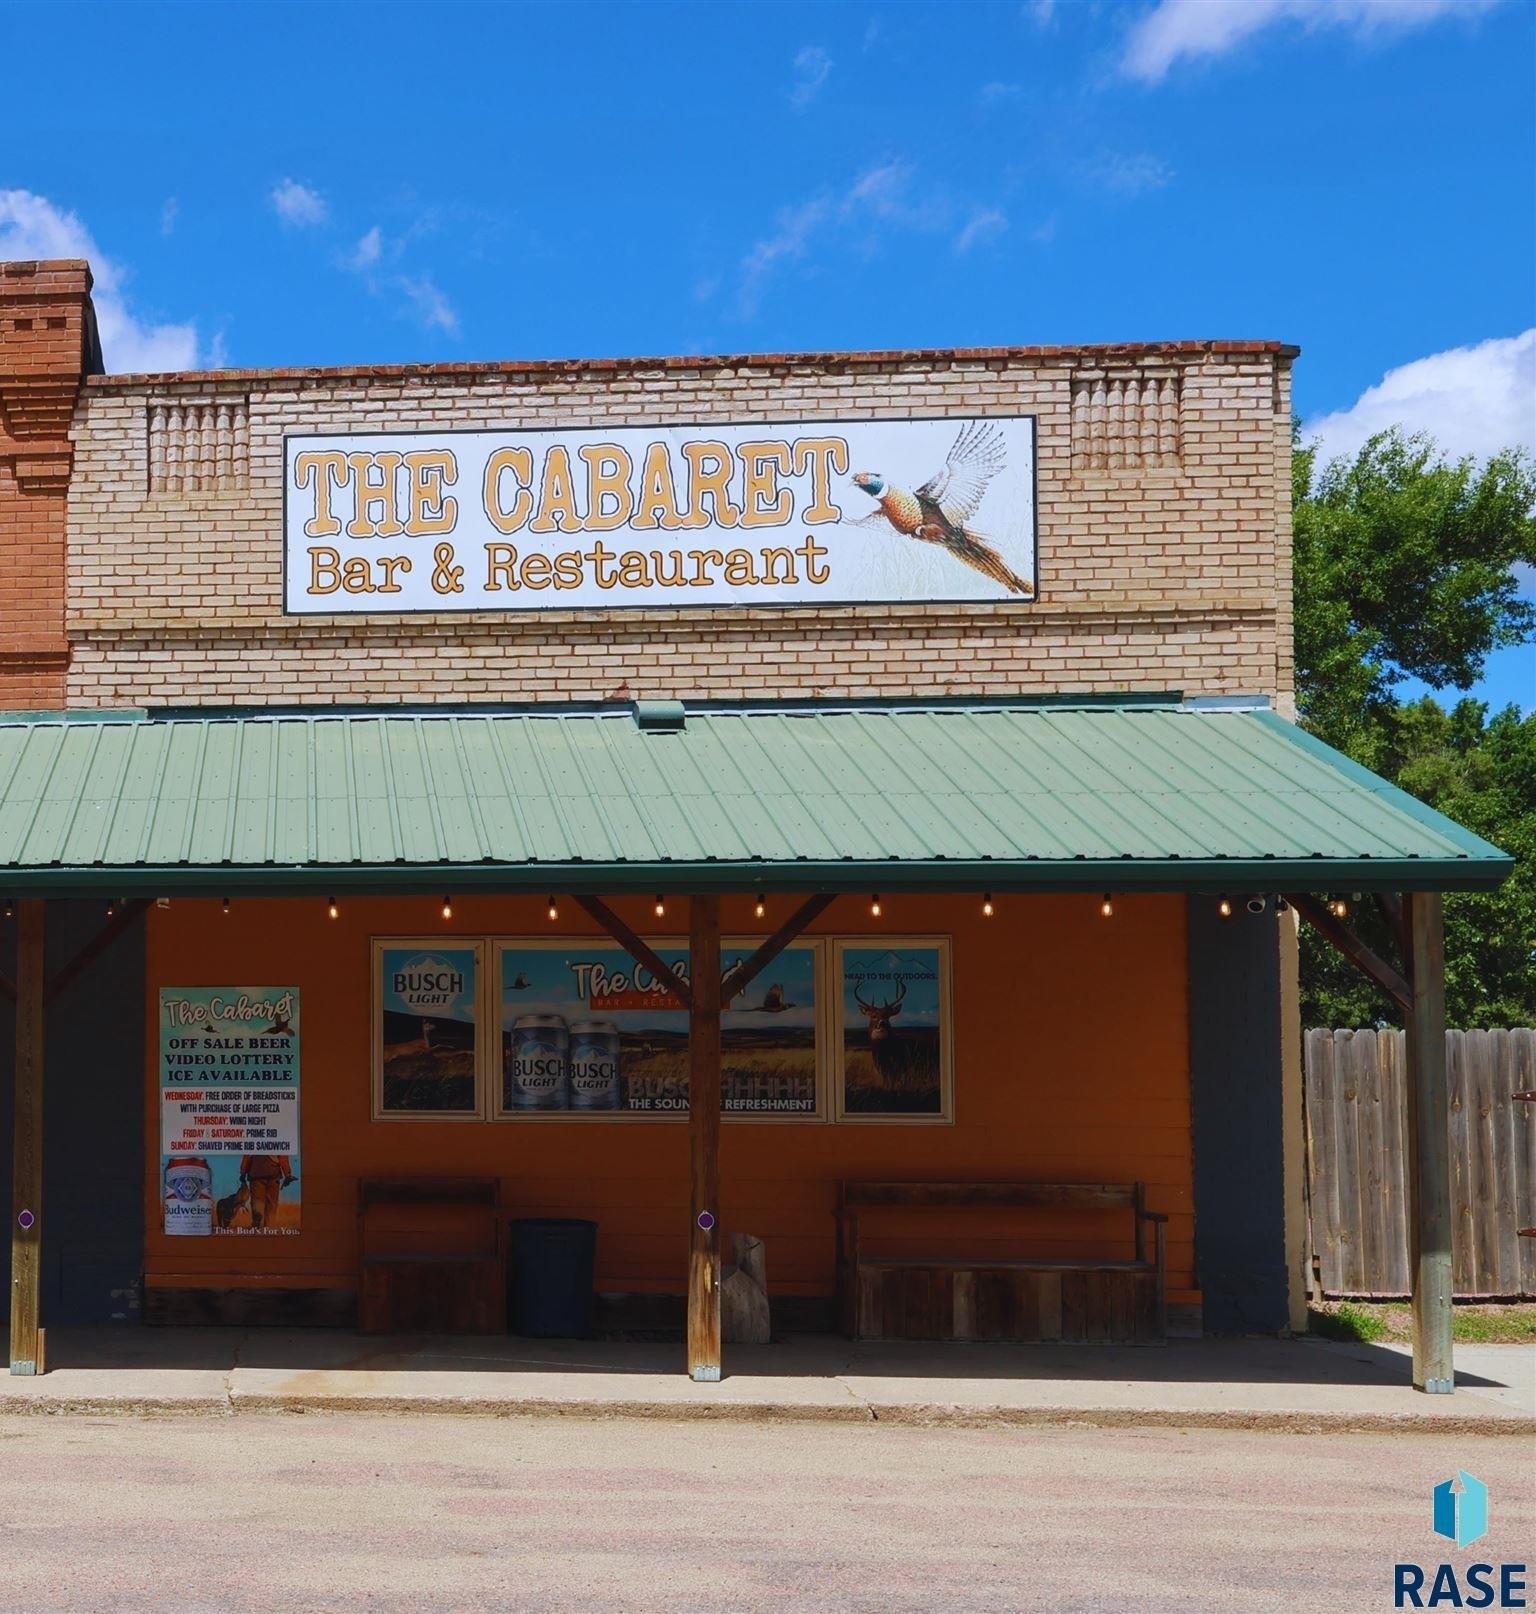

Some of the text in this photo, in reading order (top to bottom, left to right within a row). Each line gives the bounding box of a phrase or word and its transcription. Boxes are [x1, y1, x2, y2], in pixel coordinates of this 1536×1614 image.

[294, 436, 850, 537] THE CABARET
[306, 535, 830, 595] Bar & Restaurant
[393, 973, 463, 993] BUSCH
[572, 962, 629, 998] The
[409, 994, 449, 1003] LIGHT
[165, 991, 294, 1027] The Cabaret
[169, 1039, 291, 1049] OFF SALE BEER
[164, 1054, 294, 1065] VIDEO LOTTERY
[168, 1071, 292, 1081] ICE AVAILABLE
[522, 1078, 557, 1087] LIGHT
[577, 1080, 610, 1088] LIGHT
[206, 1092, 220, 1100] FREE
[221, 1092, 242, 1100] ORDER
[244, 1092, 251, 1100] OF
[253, 1092, 295, 1100] BREADSTICKS
[181, 1104, 280, 1113] WITH PURCHASE OF LARGE PIZZA
[629, 1098, 651, 1110] THE
[654, 1098, 690, 1110] SOUN
[725, 1098, 814, 1110] REFRESHMENT
[230, 1117, 246, 1125] WING
[248, 1117, 266, 1125] NIGHT
[183, 1129, 204, 1137] FRIDAY
[246, 1129, 265, 1137] PRIME
[267, 1129, 277, 1137] RIB
[198, 1142, 222, 1150] SHAVED
[224, 1142, 243, 1150] PRIME
[244, 1142, 255, 1150] RIB
[256, 1142, 290, 1150] SANDWICH
[214, 1227, 234, 1235] This
[264, 1227, 277, 1235] For
